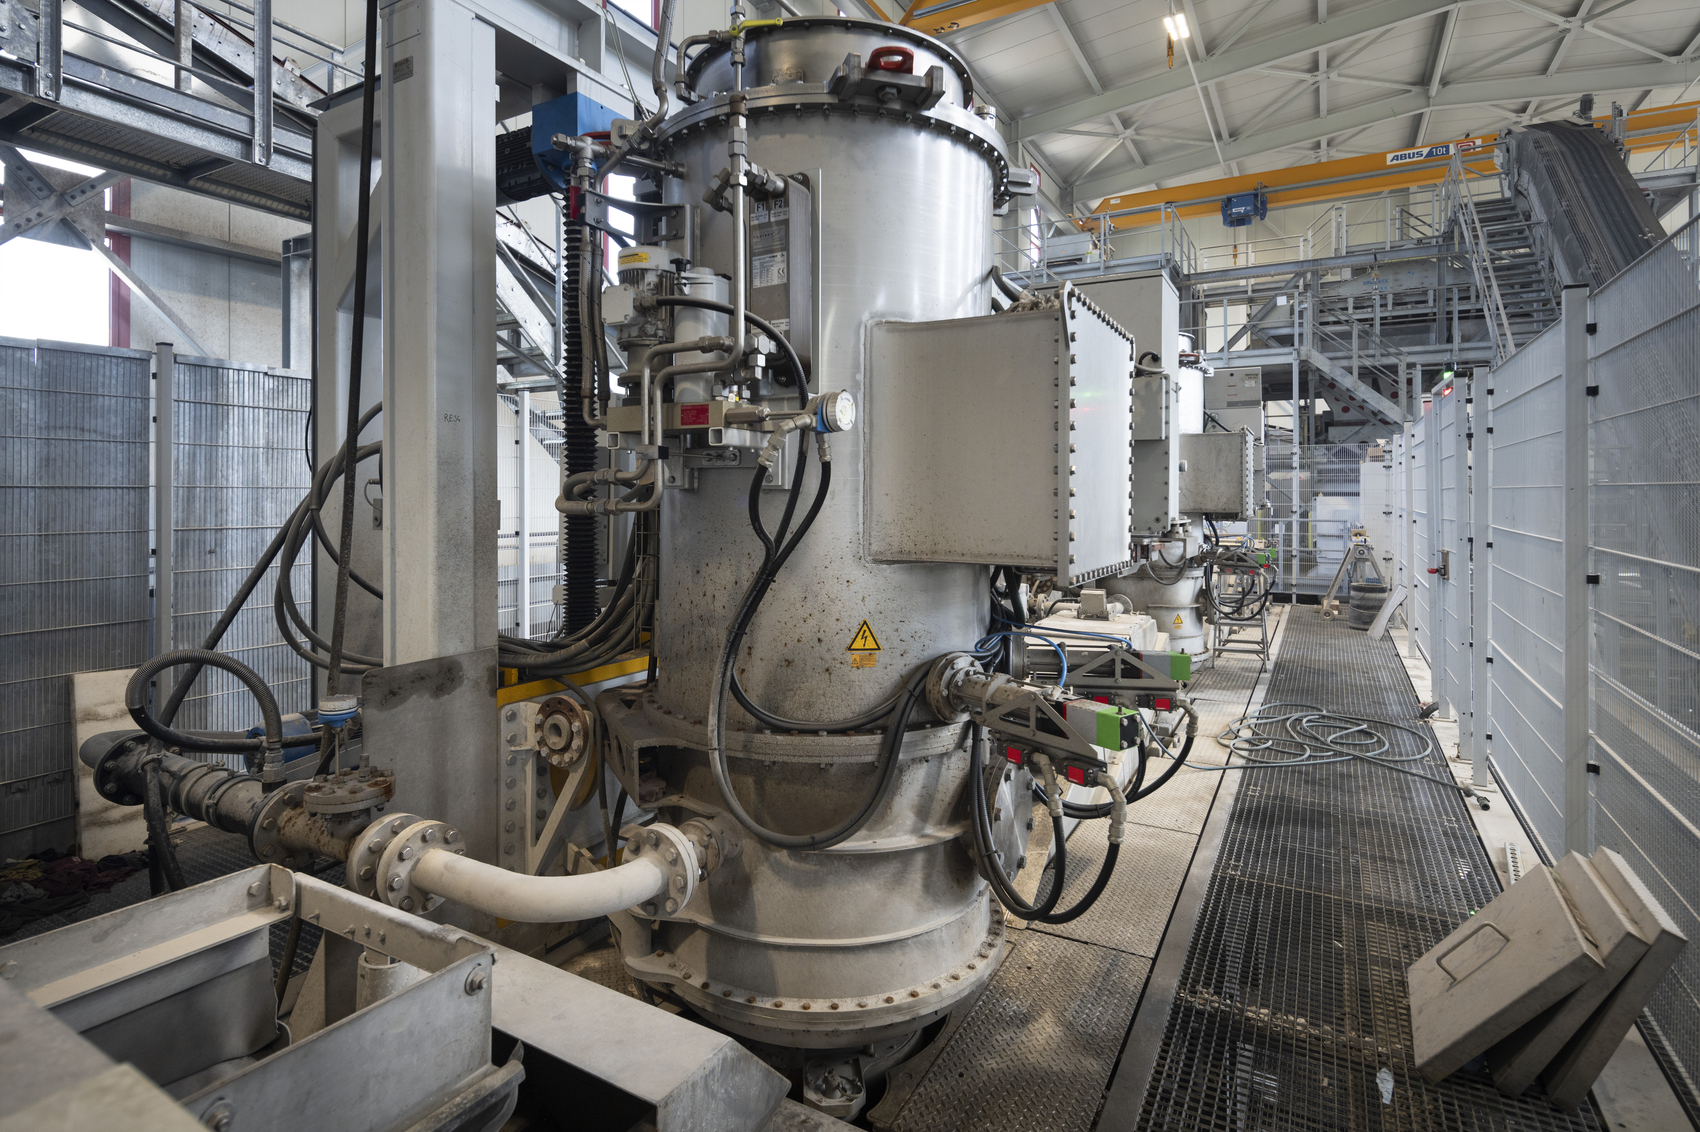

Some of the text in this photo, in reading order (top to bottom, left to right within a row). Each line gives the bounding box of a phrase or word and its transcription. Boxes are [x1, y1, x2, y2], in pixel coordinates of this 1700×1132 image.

[1390, 147, 1447, 162] ABUS 10t
[757, 202, 765, 212] F1
[774, 199, 783, 209] F2
